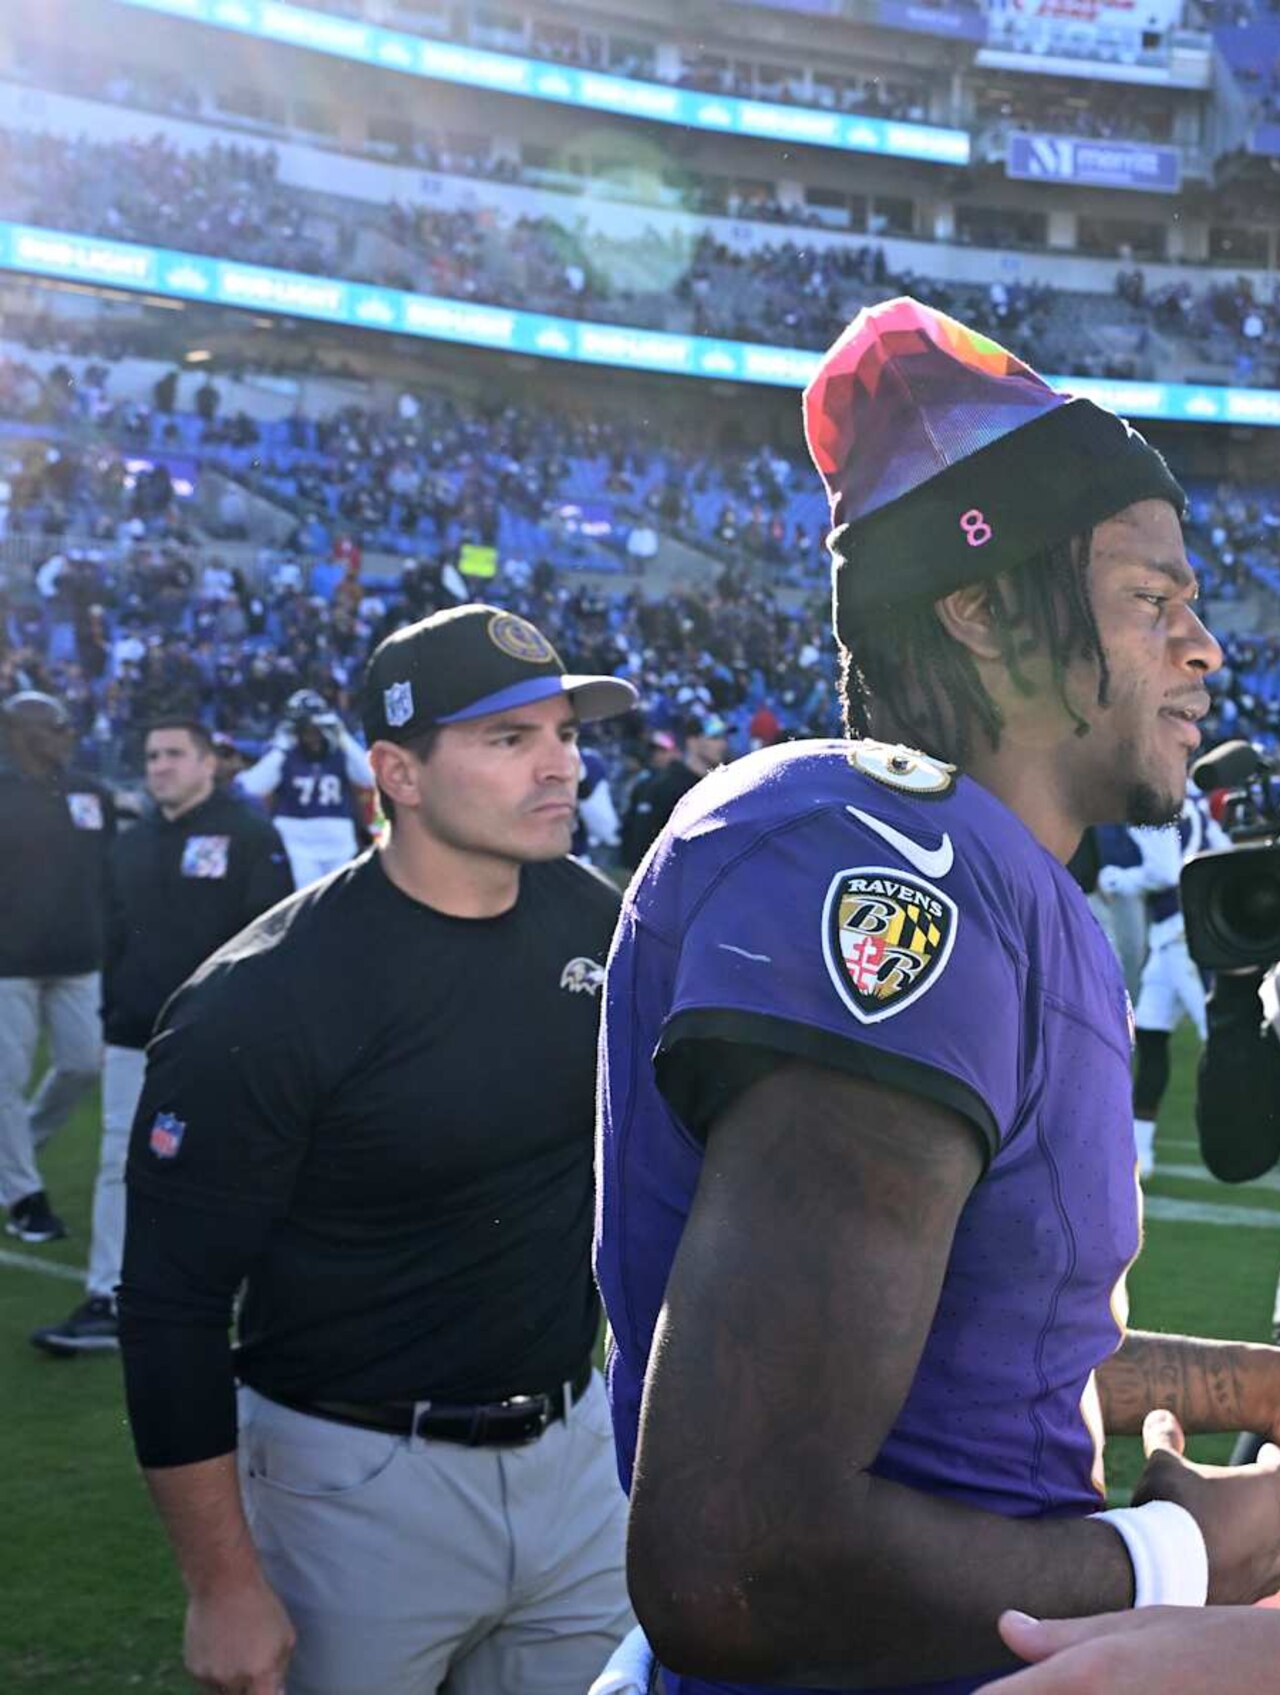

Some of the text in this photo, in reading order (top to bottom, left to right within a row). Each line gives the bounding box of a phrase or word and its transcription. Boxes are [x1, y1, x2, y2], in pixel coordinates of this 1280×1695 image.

[960, 508, 992, 547] 8
[292, 774, 342, 806] 78
[848, 878, 943, 918] RAVENS
